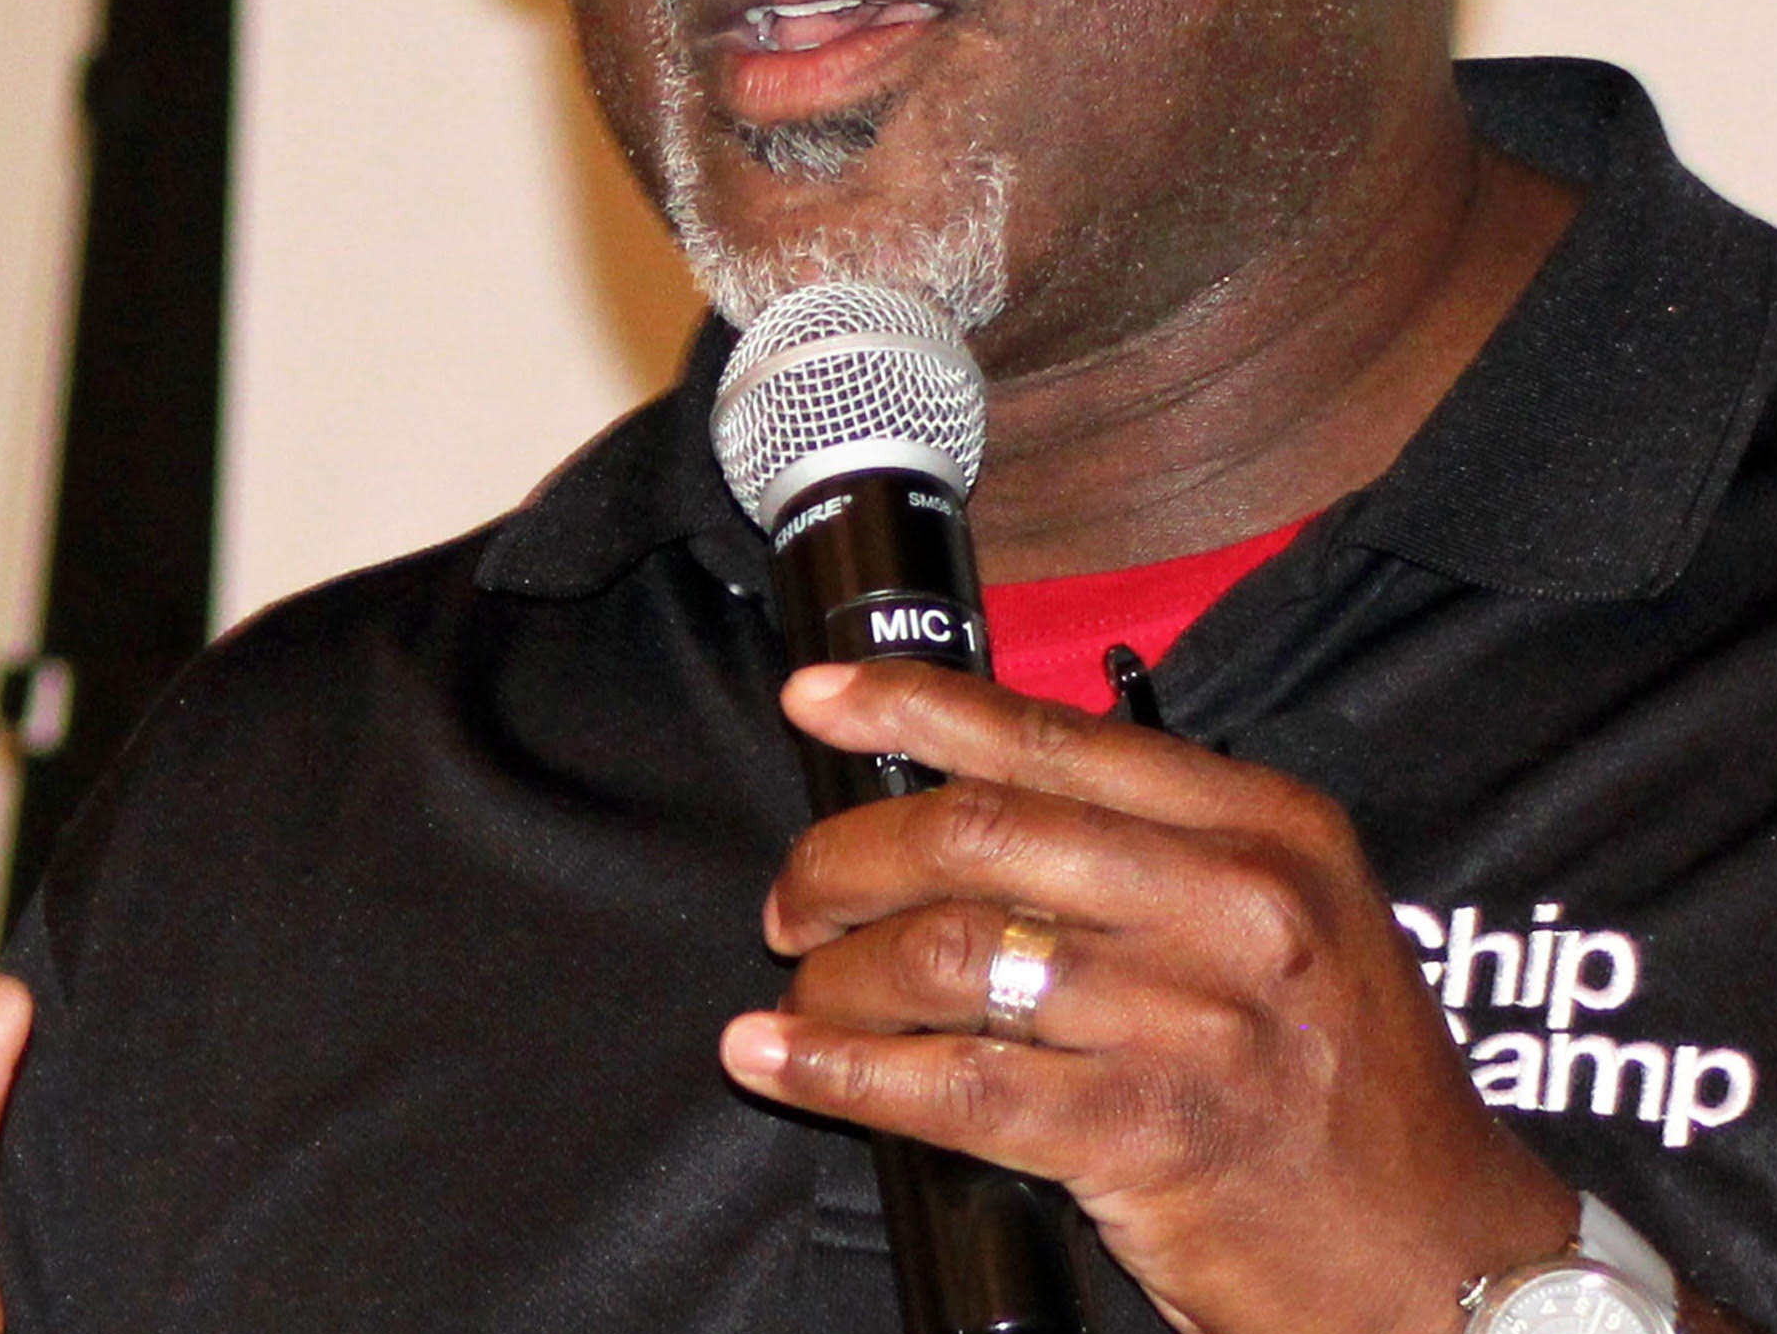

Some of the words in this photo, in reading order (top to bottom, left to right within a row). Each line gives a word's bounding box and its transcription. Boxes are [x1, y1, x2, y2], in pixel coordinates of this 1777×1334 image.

[870, 608, 951, 643] MIC
[962, 620, 976, 652] 1
[1443, 1007, 1756, 1147] amp
